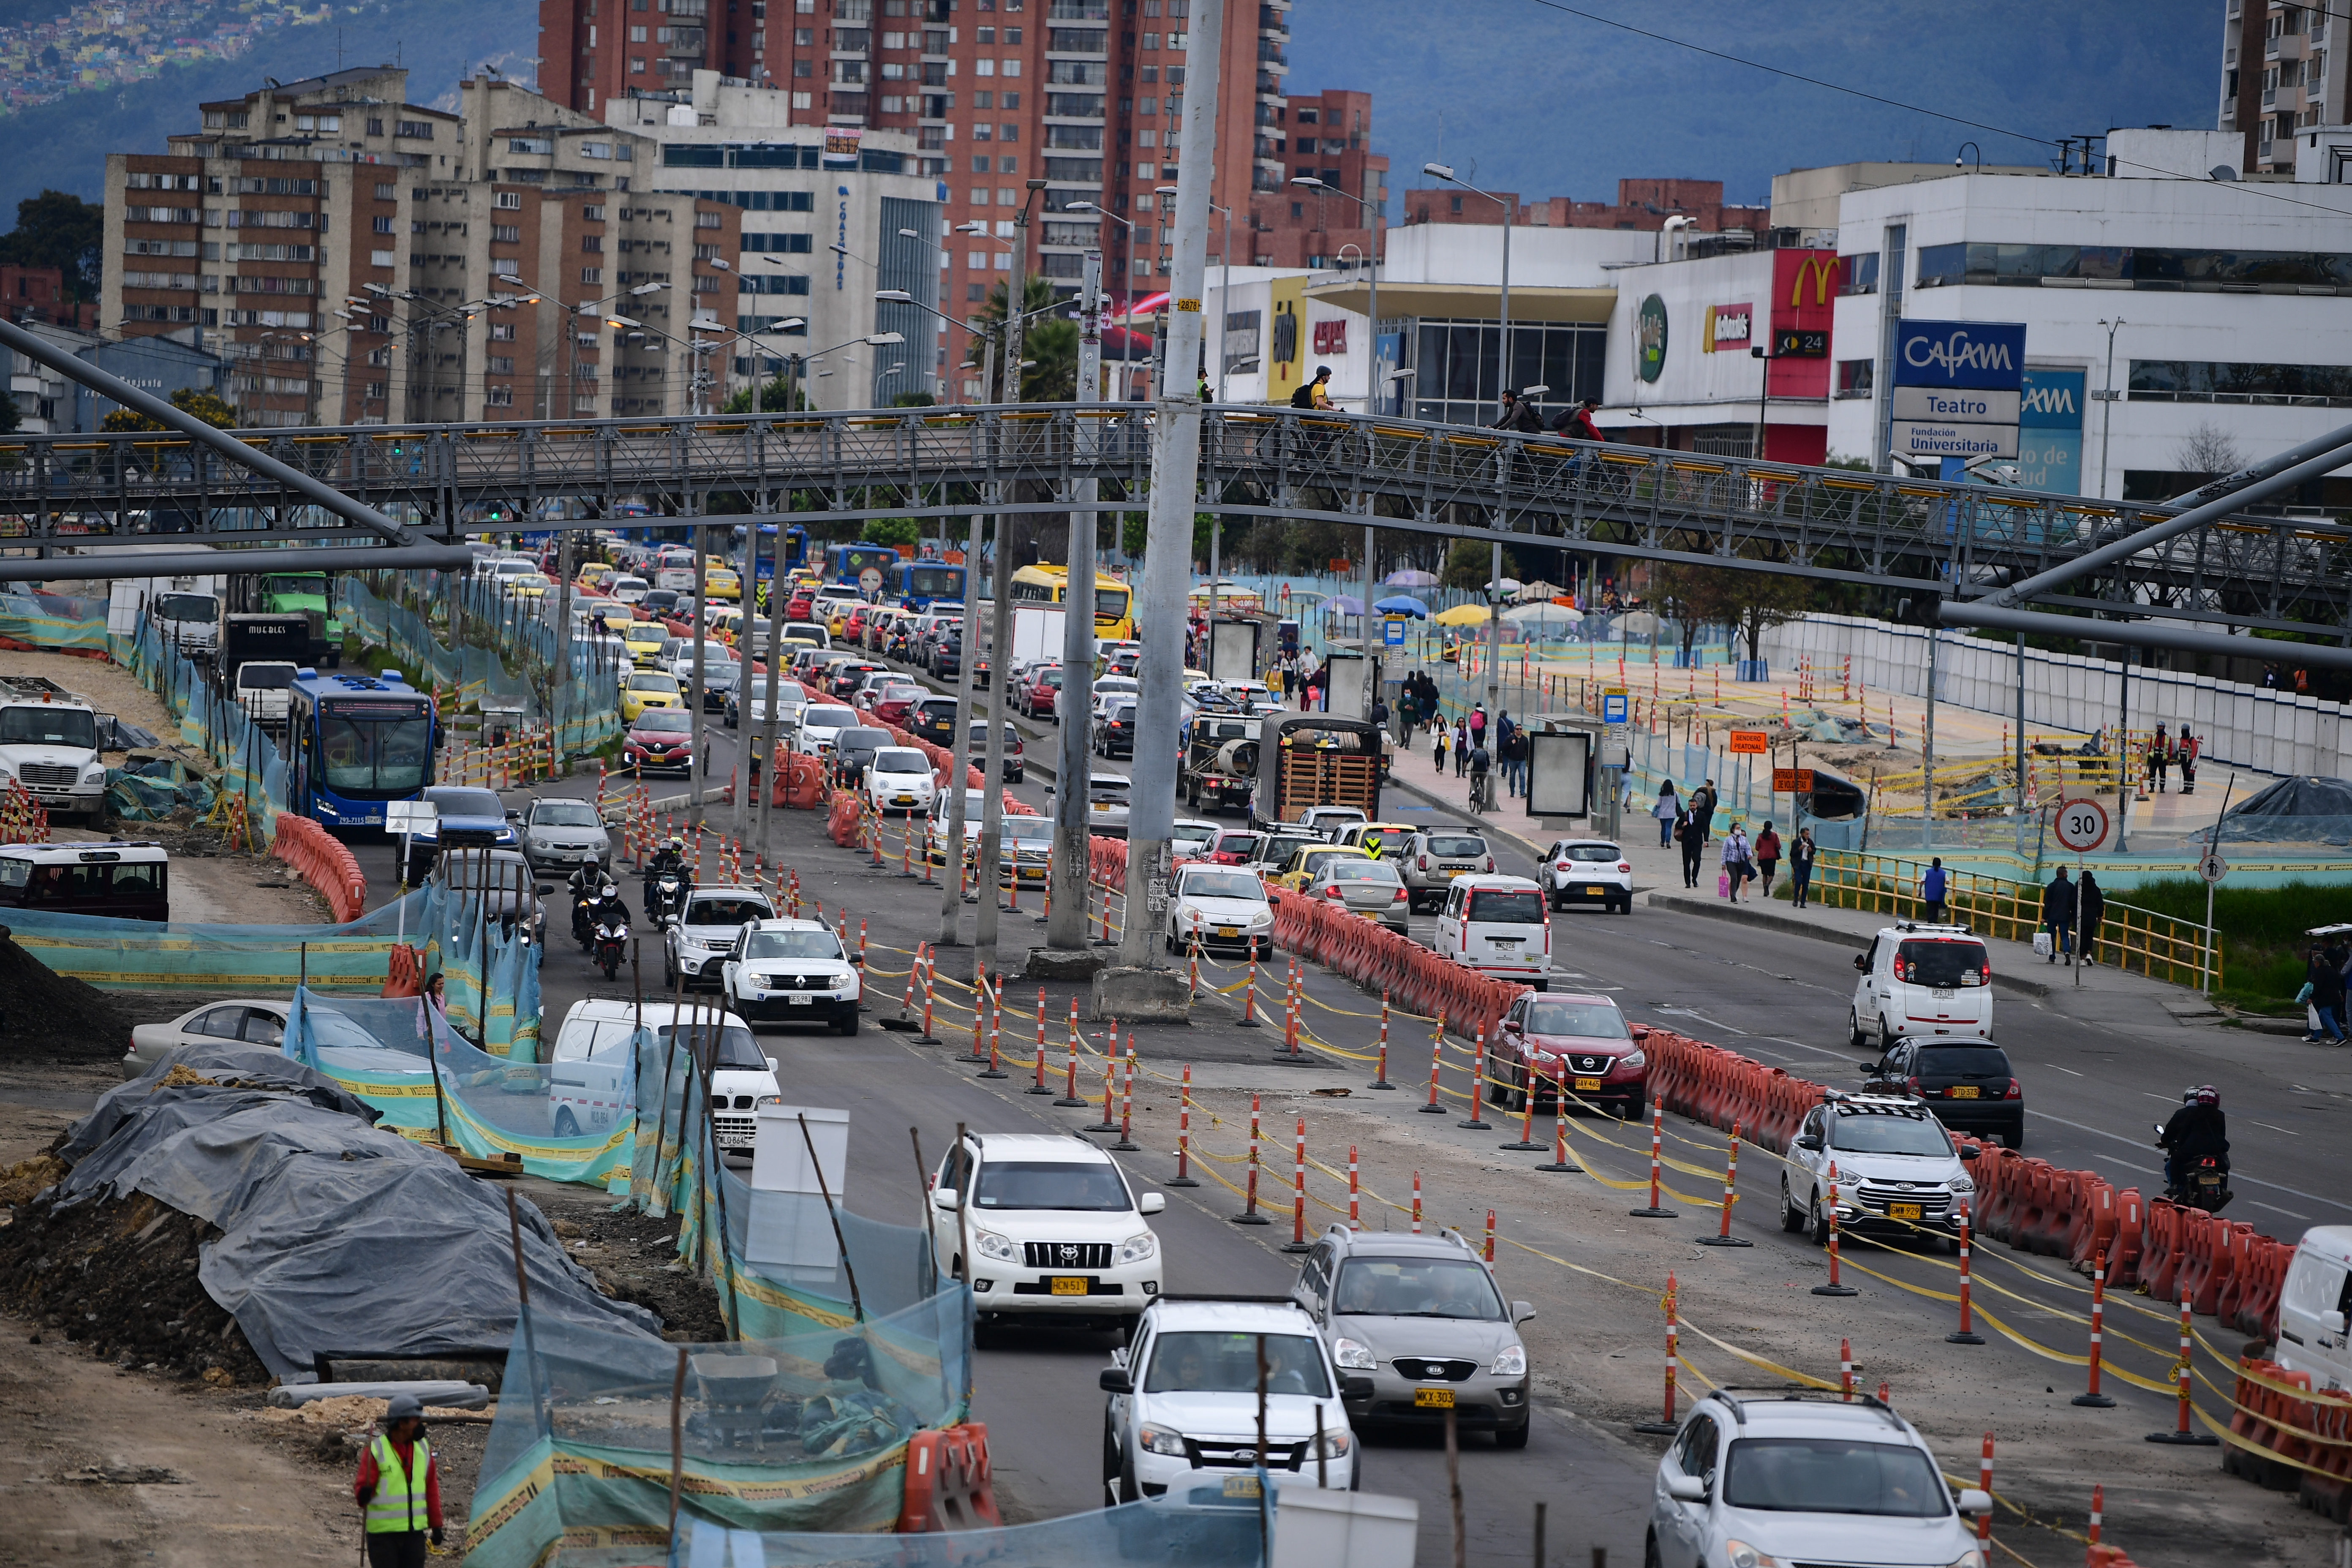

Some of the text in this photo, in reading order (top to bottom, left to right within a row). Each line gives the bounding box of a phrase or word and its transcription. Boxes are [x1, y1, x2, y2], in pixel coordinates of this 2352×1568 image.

[1181, 300, 1197, 310] 2878
[1805, 335, 1822, 348] 24
[1927, 396, 1987, 414] Teatro
[1912, 427, 1956, 438] Fundación
[1911, 437, 1998, 452] Universitaria
[2044, 445, 2067, 465] de
[249, 626, 286, 634] MUEBLES
[2071, 816, 2095, 835] 30
